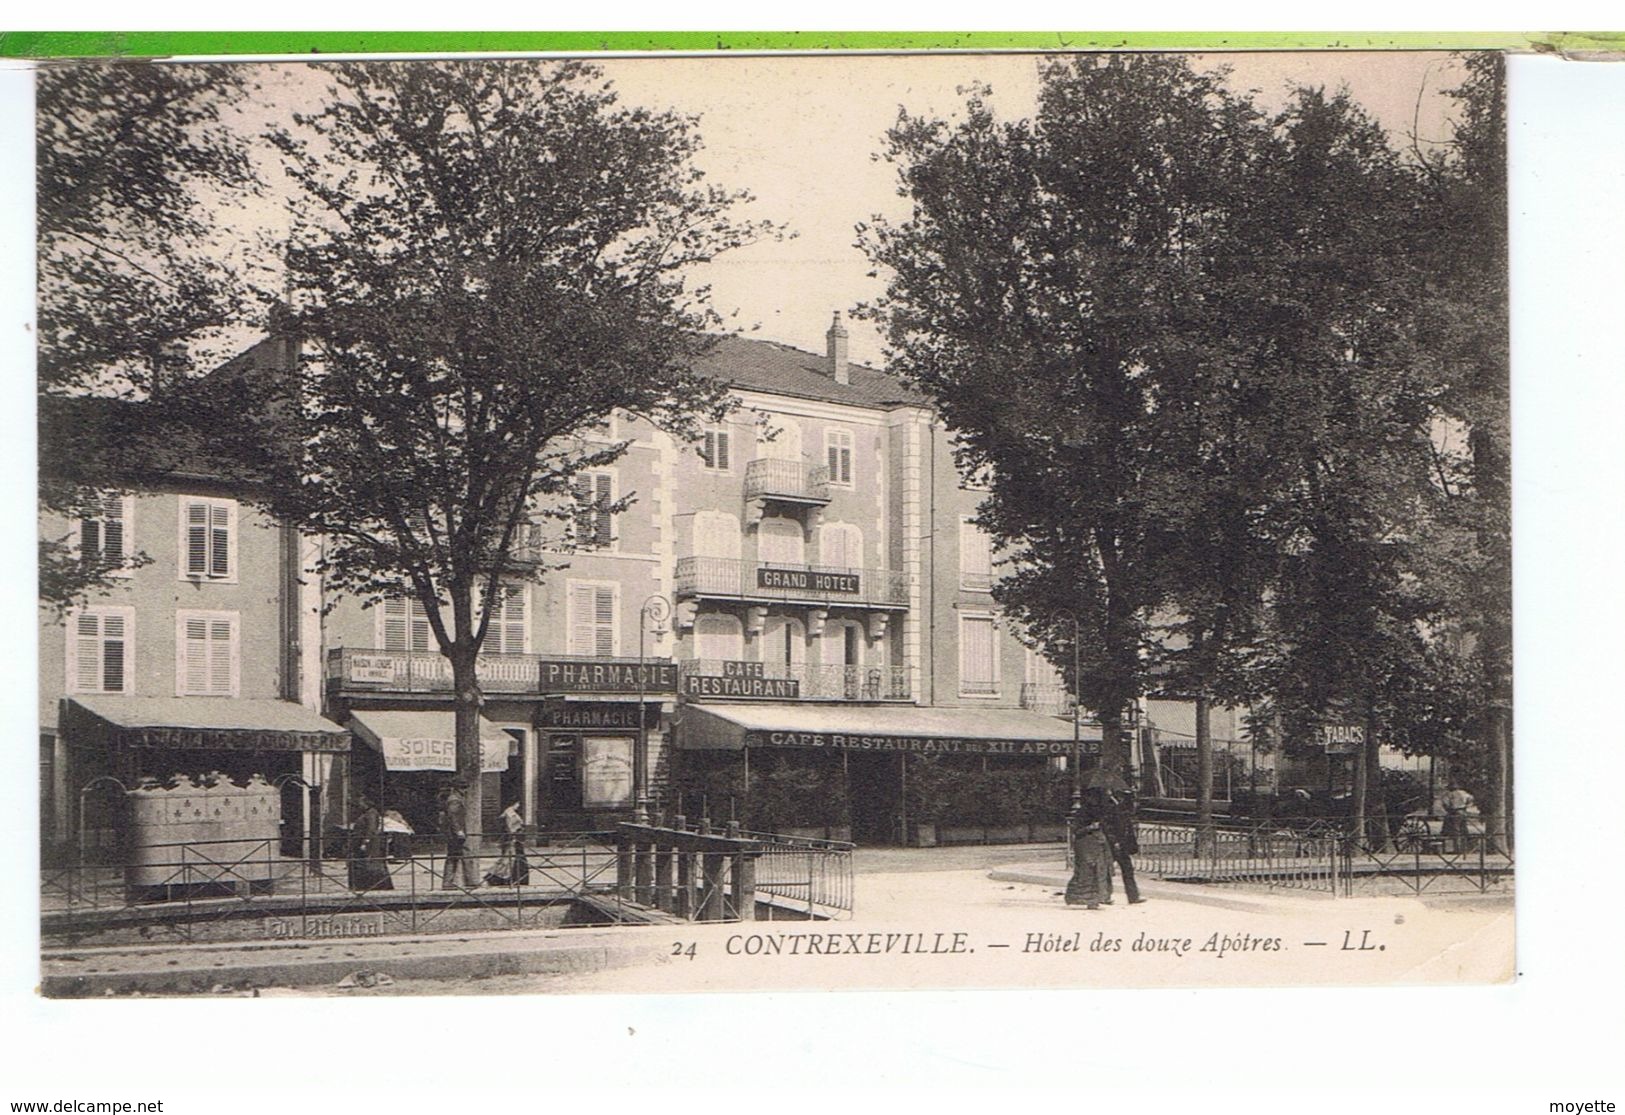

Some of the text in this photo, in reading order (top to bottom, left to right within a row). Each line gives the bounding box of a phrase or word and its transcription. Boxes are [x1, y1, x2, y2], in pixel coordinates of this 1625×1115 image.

[764, 571, 854, 591] GRAND HOTEL
[549, 664, 670, 685] PHARMACIE
[726, 662, 763, 677] CAFE
[690, 677, 797, 697] RESTAURANT
[553, 711, 635, 726] PHARMACIE
[832, 734, 961, 753] RESTAURANT
[1324, 726, 1363, 744] TABACS
